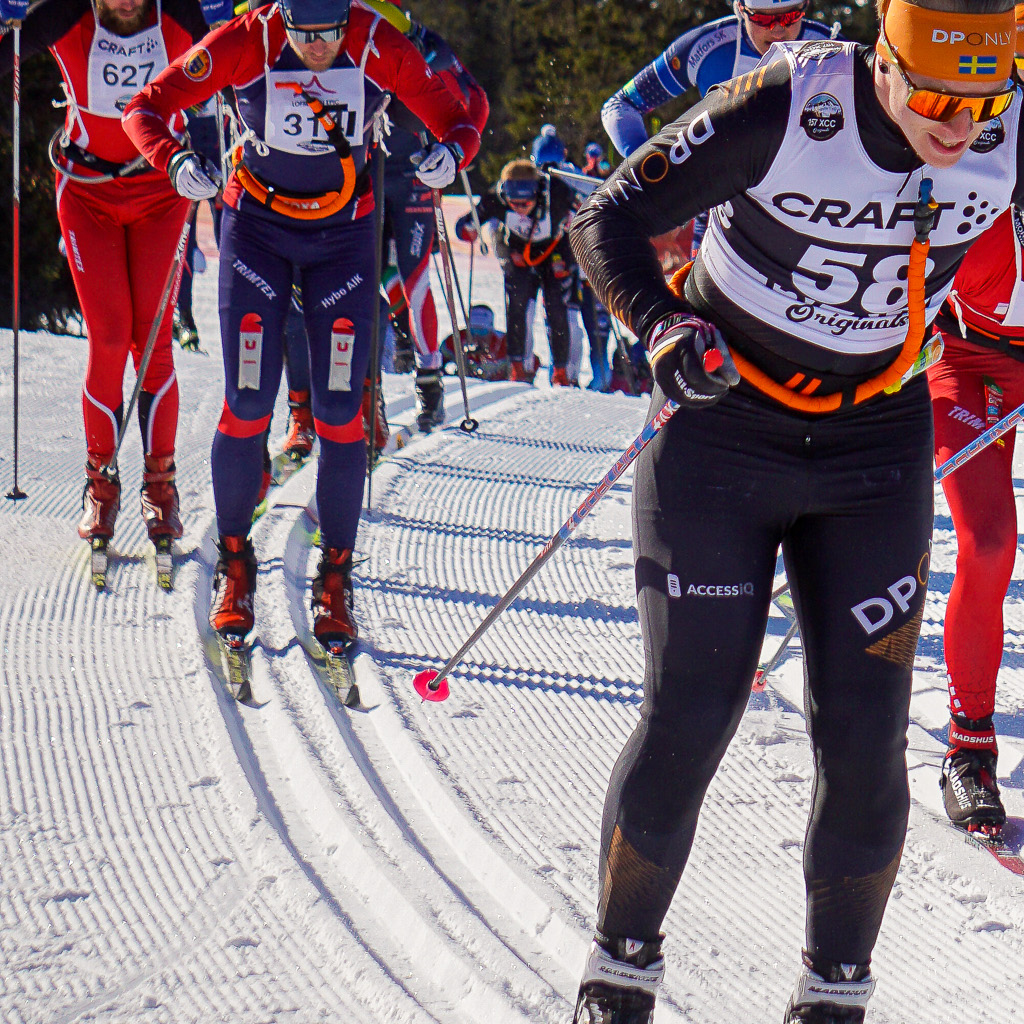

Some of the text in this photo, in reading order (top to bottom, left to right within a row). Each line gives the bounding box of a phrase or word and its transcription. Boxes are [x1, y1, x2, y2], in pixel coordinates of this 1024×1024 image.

[97, 38, 145, 57] CRAFT
[688, 30, 728, 69] Matfors SK
[931, 28, 1012, 46] DPONLY
[102, 62, 156, 87] 627
[819, 119, 836, 127] XCC
[771, 191, 956, 231] CRAFT
[232, 259, 277, 301] TRIMTEX
[320, 273, 364, 308] Hybo AIK
[791, 244, 936, 315] 58
[785, 303, 909, 336] Originals
[947, 405, 987, 434] TRIM
[951, 731, 995, 743] MADSHUS
[949, 767, 972, 809] MADSHUS
